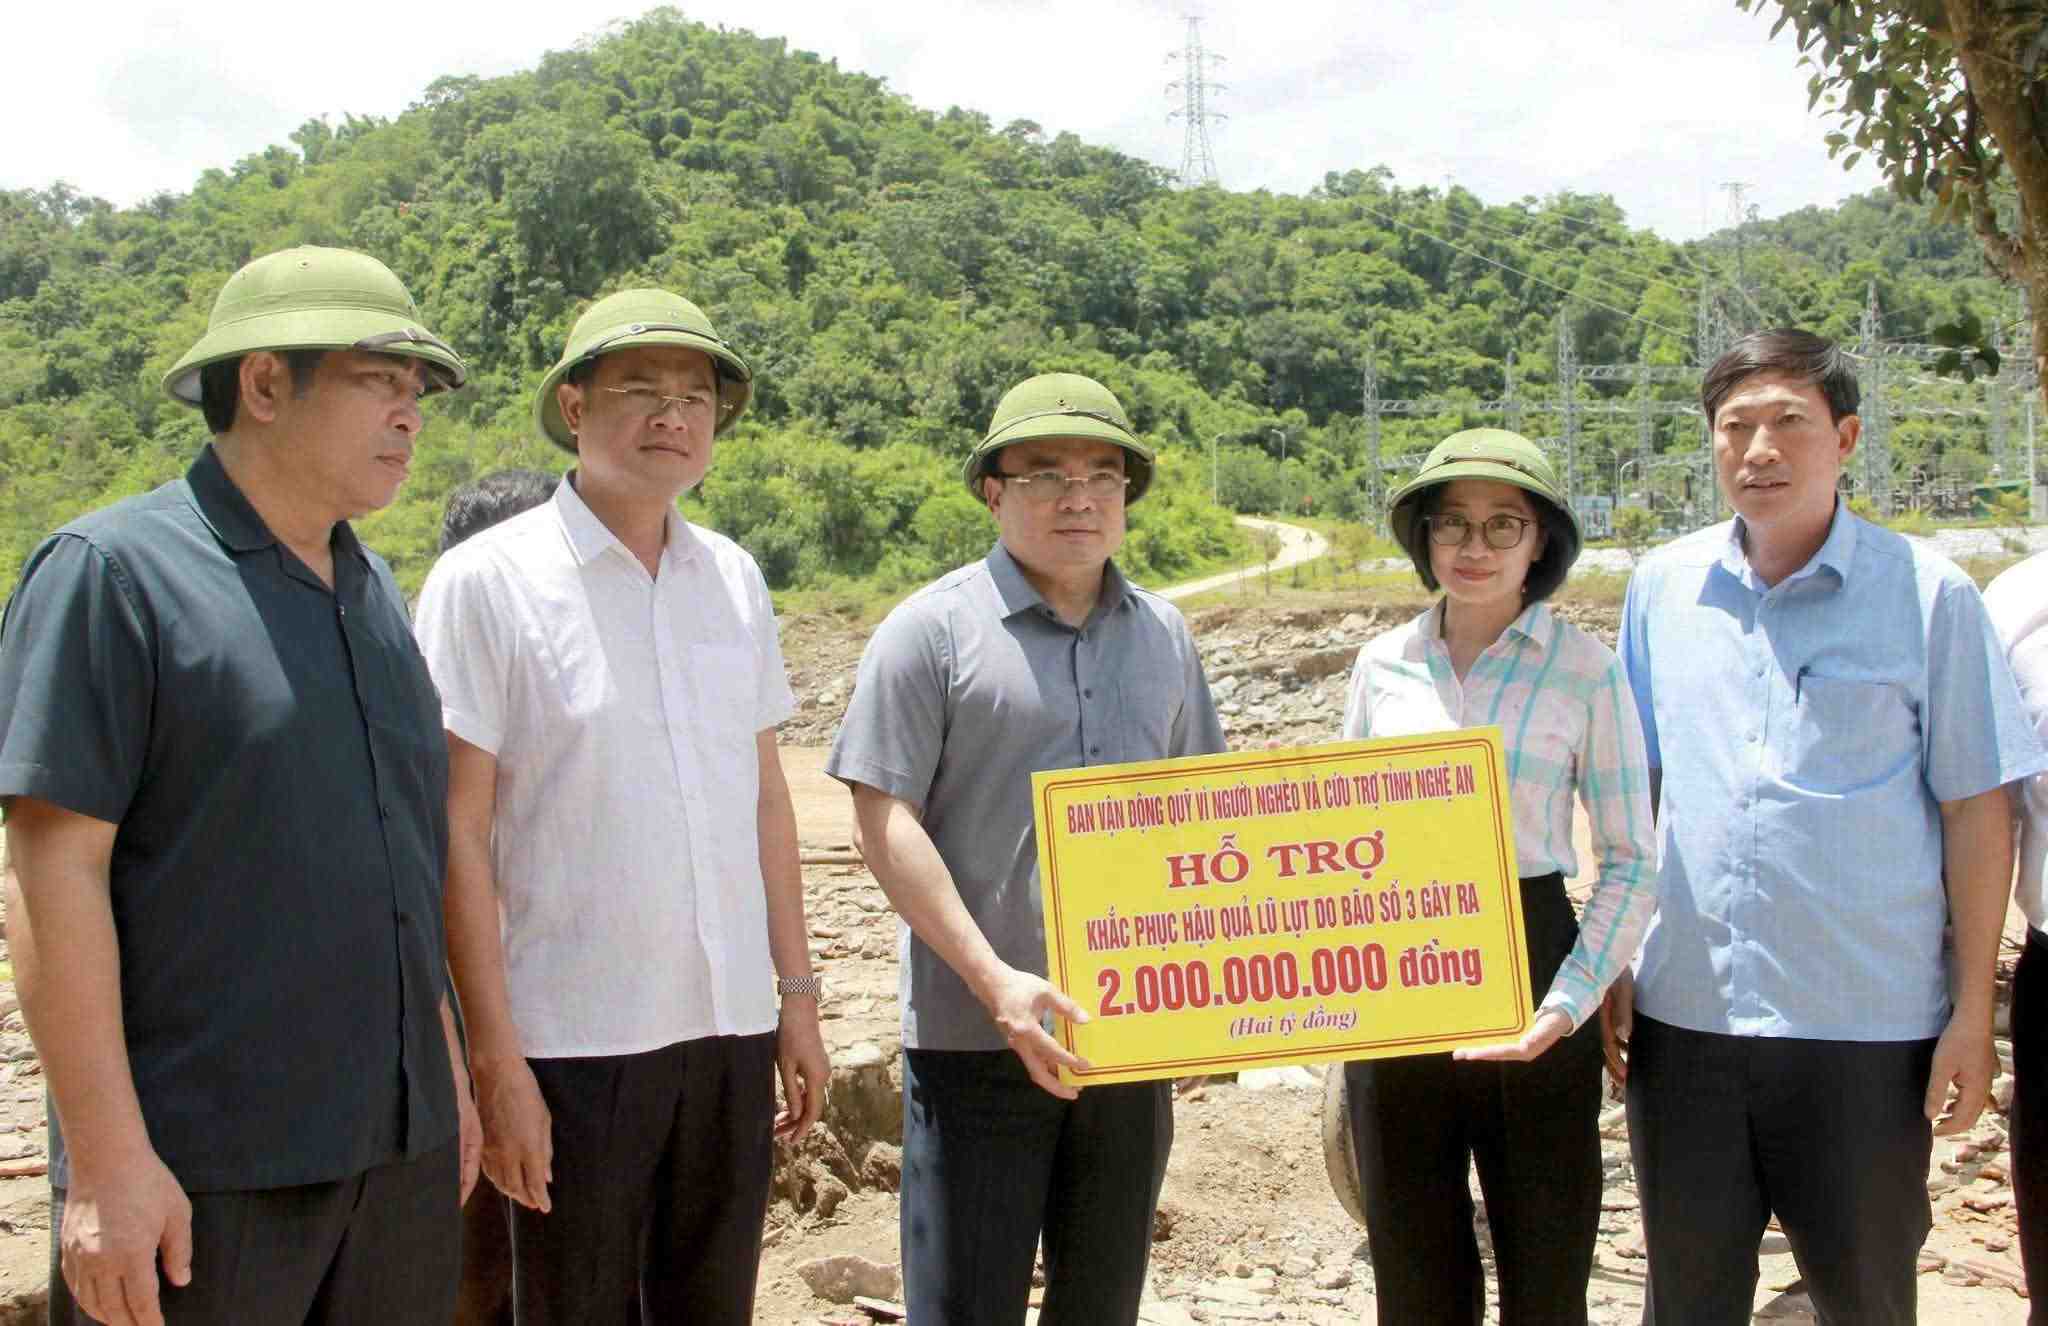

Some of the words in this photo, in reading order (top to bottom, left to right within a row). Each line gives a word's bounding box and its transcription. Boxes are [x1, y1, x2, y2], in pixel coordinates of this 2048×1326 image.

[1068, 804, 1095, 833] BAN
[1098, 795, 1125, 836] VẬN
[1127, 792, 1164, 833] ĐỘNG
[1167, 788, 1191, 827] QUỸ
[1195, 787, 1209, 821] VÌ
[1212, 782, 1253, 819] NGƯỜI
[1256, 778, 1300, 815] NGHÈO
[1324, 772, 1351, 808] CỨU
[1353, 772, 1379, 810] TRỢ
[1416, 761, 1452, 802] NGHỆ
[1456, 765, 1474, 794] AN
[1166, 834, 1249, 888] HỖ
[1267, 830, 1384, 880] TRỢ
[1087, 906, 1130, 951] KHẮC
[1134, 912, 1178, 951] PHỤC
[1182, 904, 1215, 948] HẬU
[1220, 896, 1254, 941] QUẢ
[1257, 897, 1277, 934] LŨ
[1281, 900, 1309, 938] LỤT
[1314, 897, 1337, 928] DO
[1341, 889, 1374, 926] BÃO
[1379, 880, 1401, 922] SỐ
[1406, 890, 1416, 920] 3
[1421, 880, 1451, 918] GÂY
[1456, 883, 1479, 914] RA
[1098, 943, 1387, 1016] 2.000.000.000
[1400, 939, 1482, 987] đồng
[1230, 1016, 1272, 1038] (Hai
[1303, 1005, 1356, 1030] đồng)
